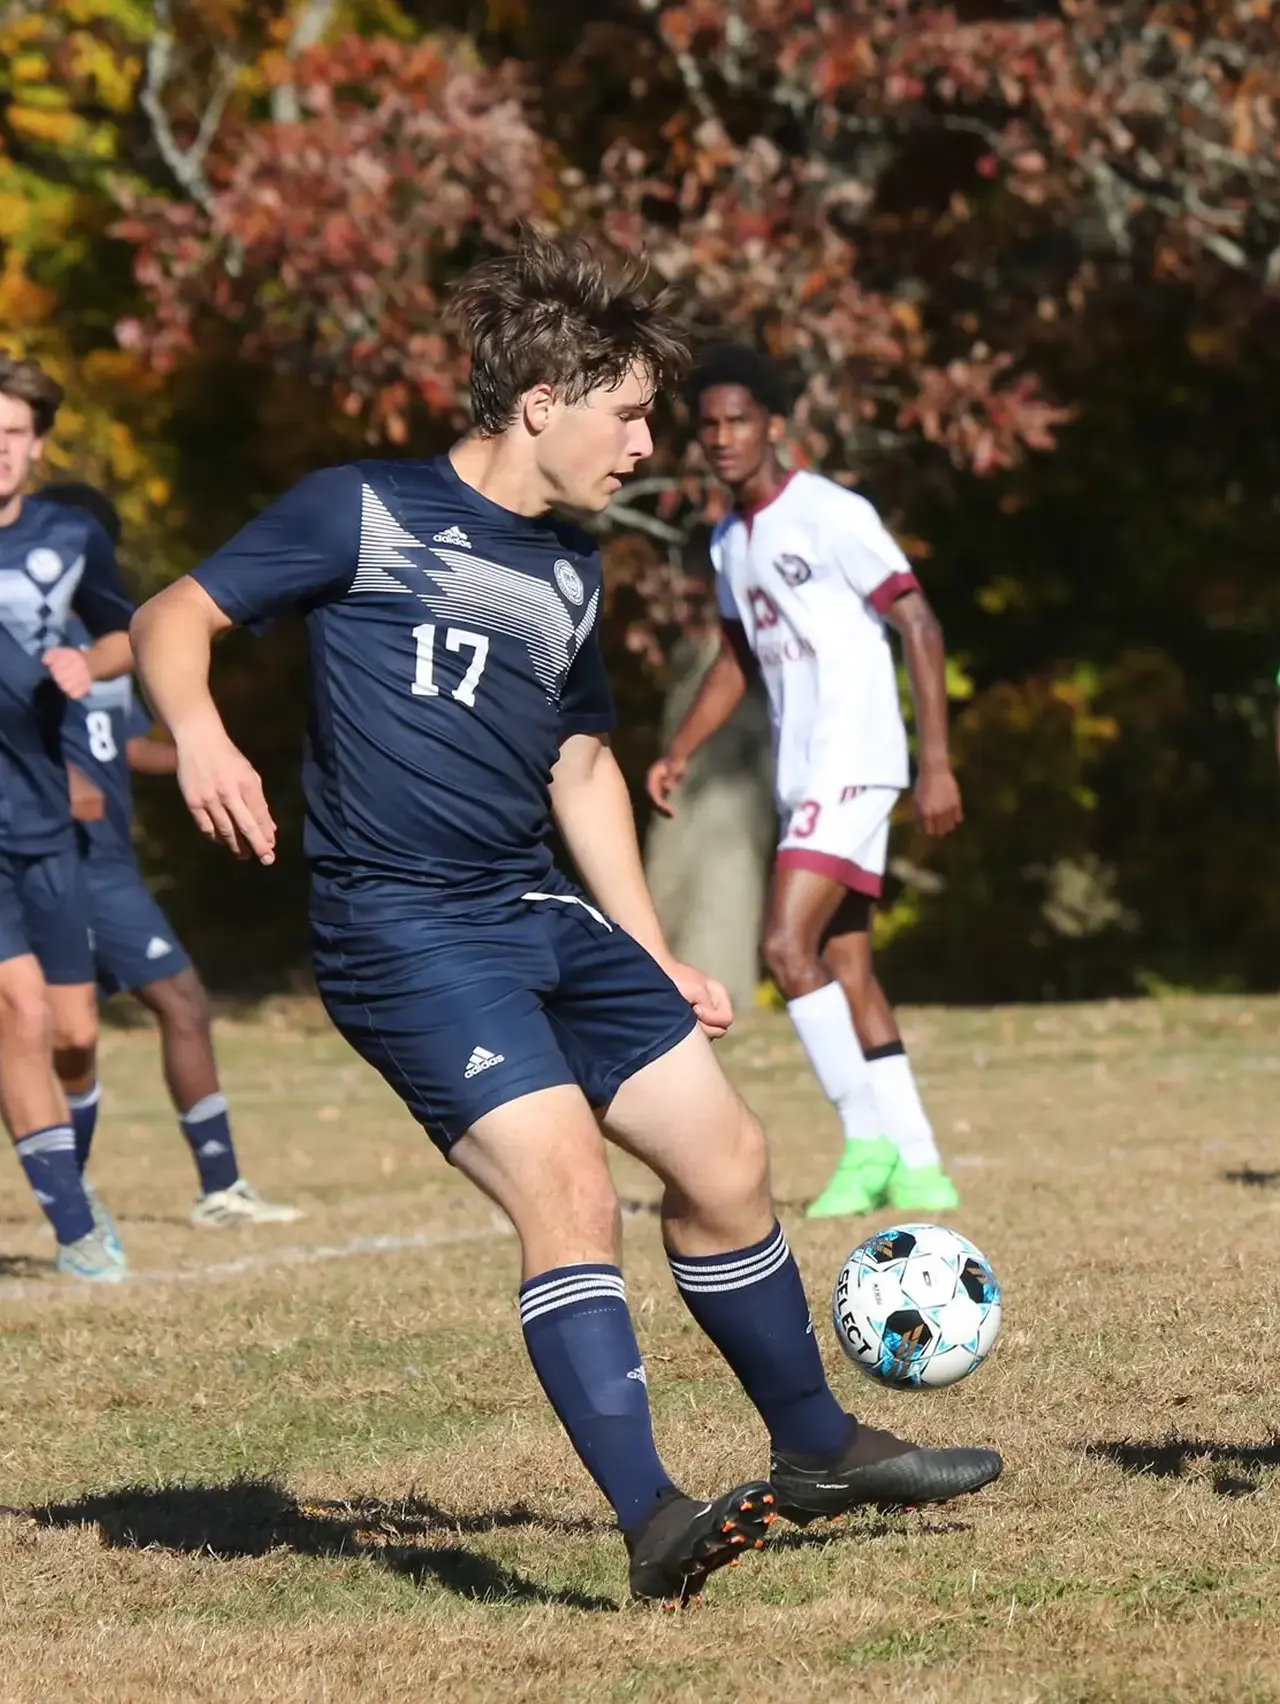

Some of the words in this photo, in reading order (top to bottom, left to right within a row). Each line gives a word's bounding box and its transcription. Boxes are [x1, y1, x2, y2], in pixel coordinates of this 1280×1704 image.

[433, 534, 472, 549] adidas
[411, 623, 489, 708] 17
[86, 710, 118, 762] 8
[464, 1054, 505, 1079] adidas
[836, 1268, 873, 1355] SELECT
